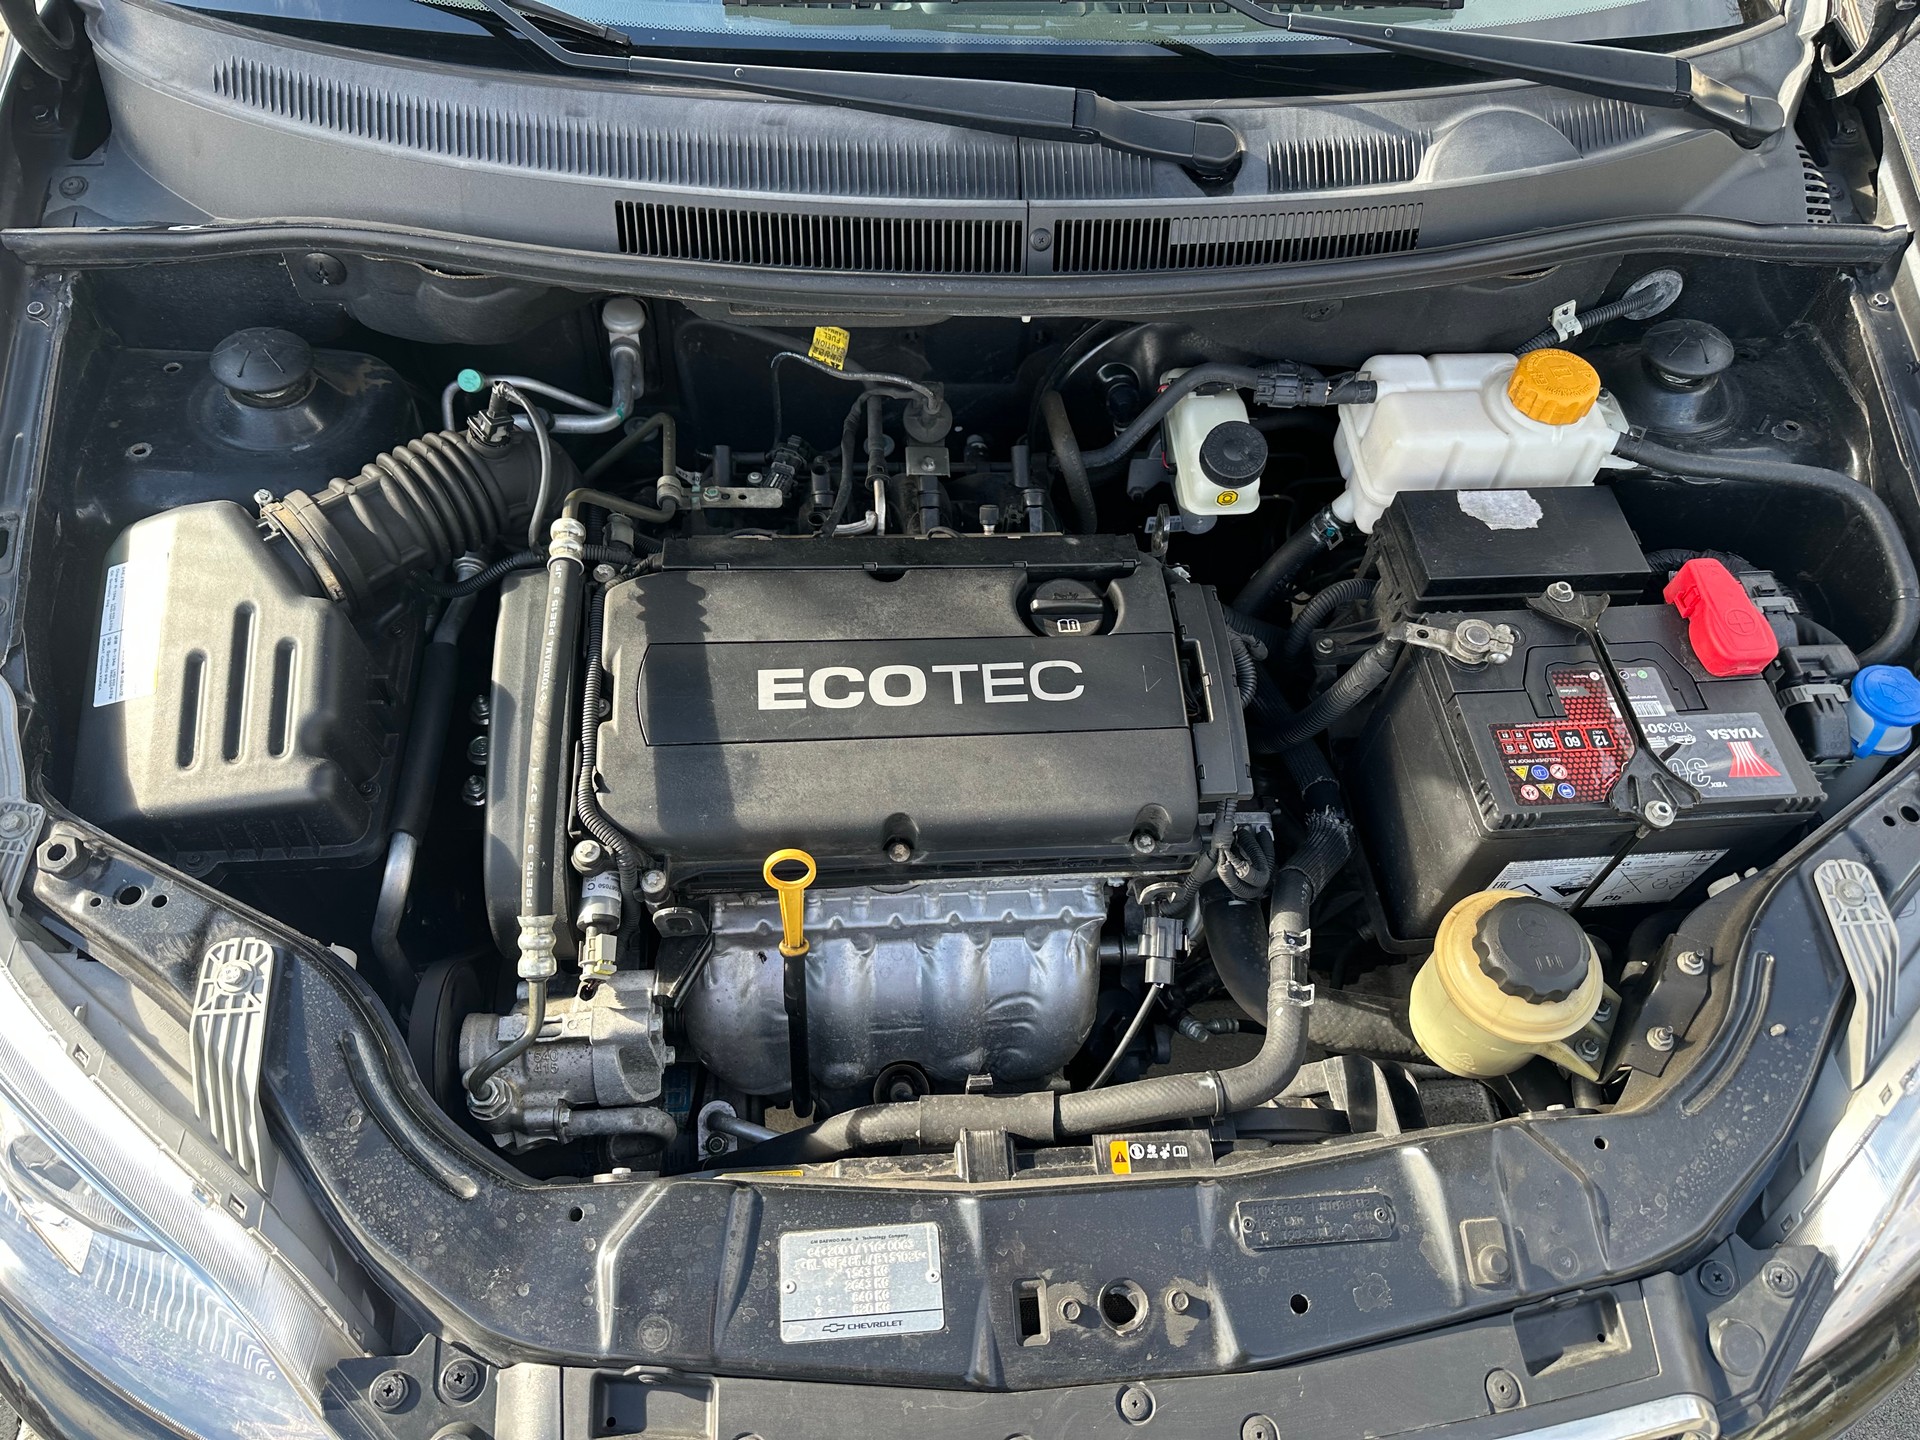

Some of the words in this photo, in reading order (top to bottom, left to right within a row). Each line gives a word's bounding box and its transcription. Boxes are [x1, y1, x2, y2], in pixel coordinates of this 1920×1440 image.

[824, 332, 840, 343] FUEL
[815, 338, 845, 354] CAUTION
[541, 640, 554, 692] YOKOHAMA
[548, 599, 559, 636] PSE15
[758, 659, 1086, 710] ECOTEC
[1641, 722, 1694, 734] YBX301
[1706, 728, 1764, 740] YUASA
[1532, 737, 1556, 748] 500
[1564, 736, 1581, 747] 60
[1593, 735, 1609, 746] 12
[528, 814, 535, 833] JF
[526, 861, 534, 907] PSE15
[534, 1050, 558, 1062] 540
[534, 1062, 559, 1074] 415
[874, 1264, 890, 1277] KG
[874, 1277, 890, 1290] KG
[874, 1289, 890, 1301] KG
[874, 1302, 890, 1314] KG
[848, 1320, 903, 1330] CHEVROLET
